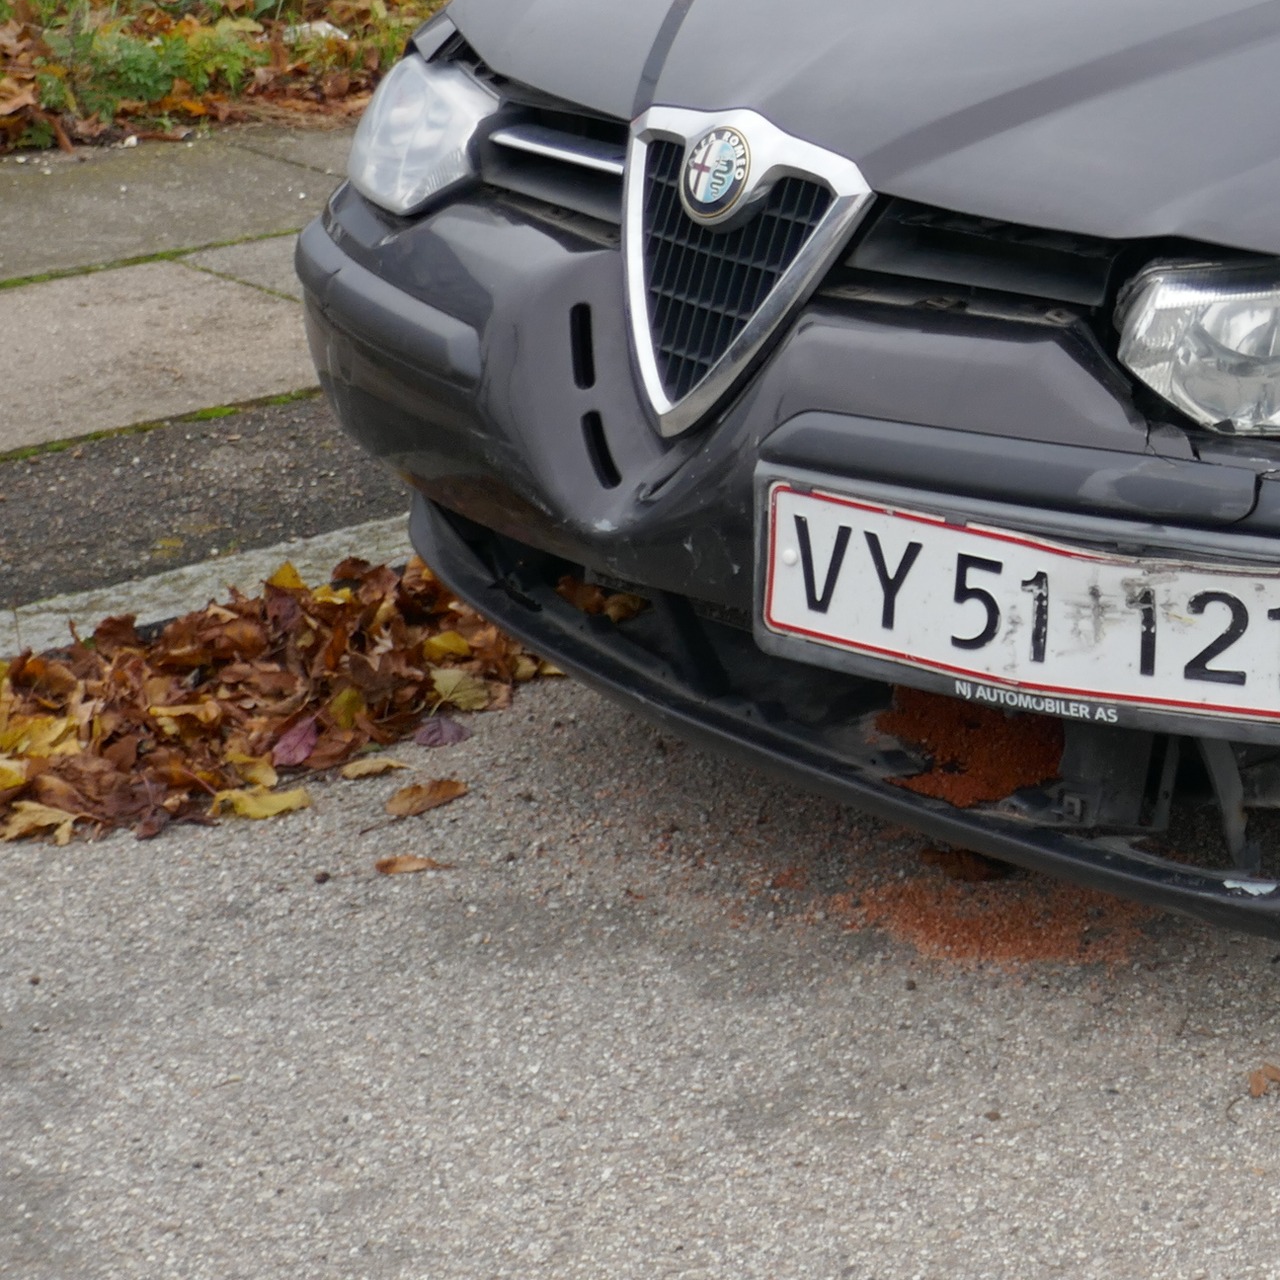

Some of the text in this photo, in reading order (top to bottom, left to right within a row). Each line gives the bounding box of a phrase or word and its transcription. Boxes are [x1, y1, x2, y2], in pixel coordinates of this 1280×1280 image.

[722, 131, 746, 180] ROMEO
[793, 514, 923, 631] VY
[950, 552, 1049, 663] 51
[954, 680, 1119, 723] NJ AUTOMOBILER AS
